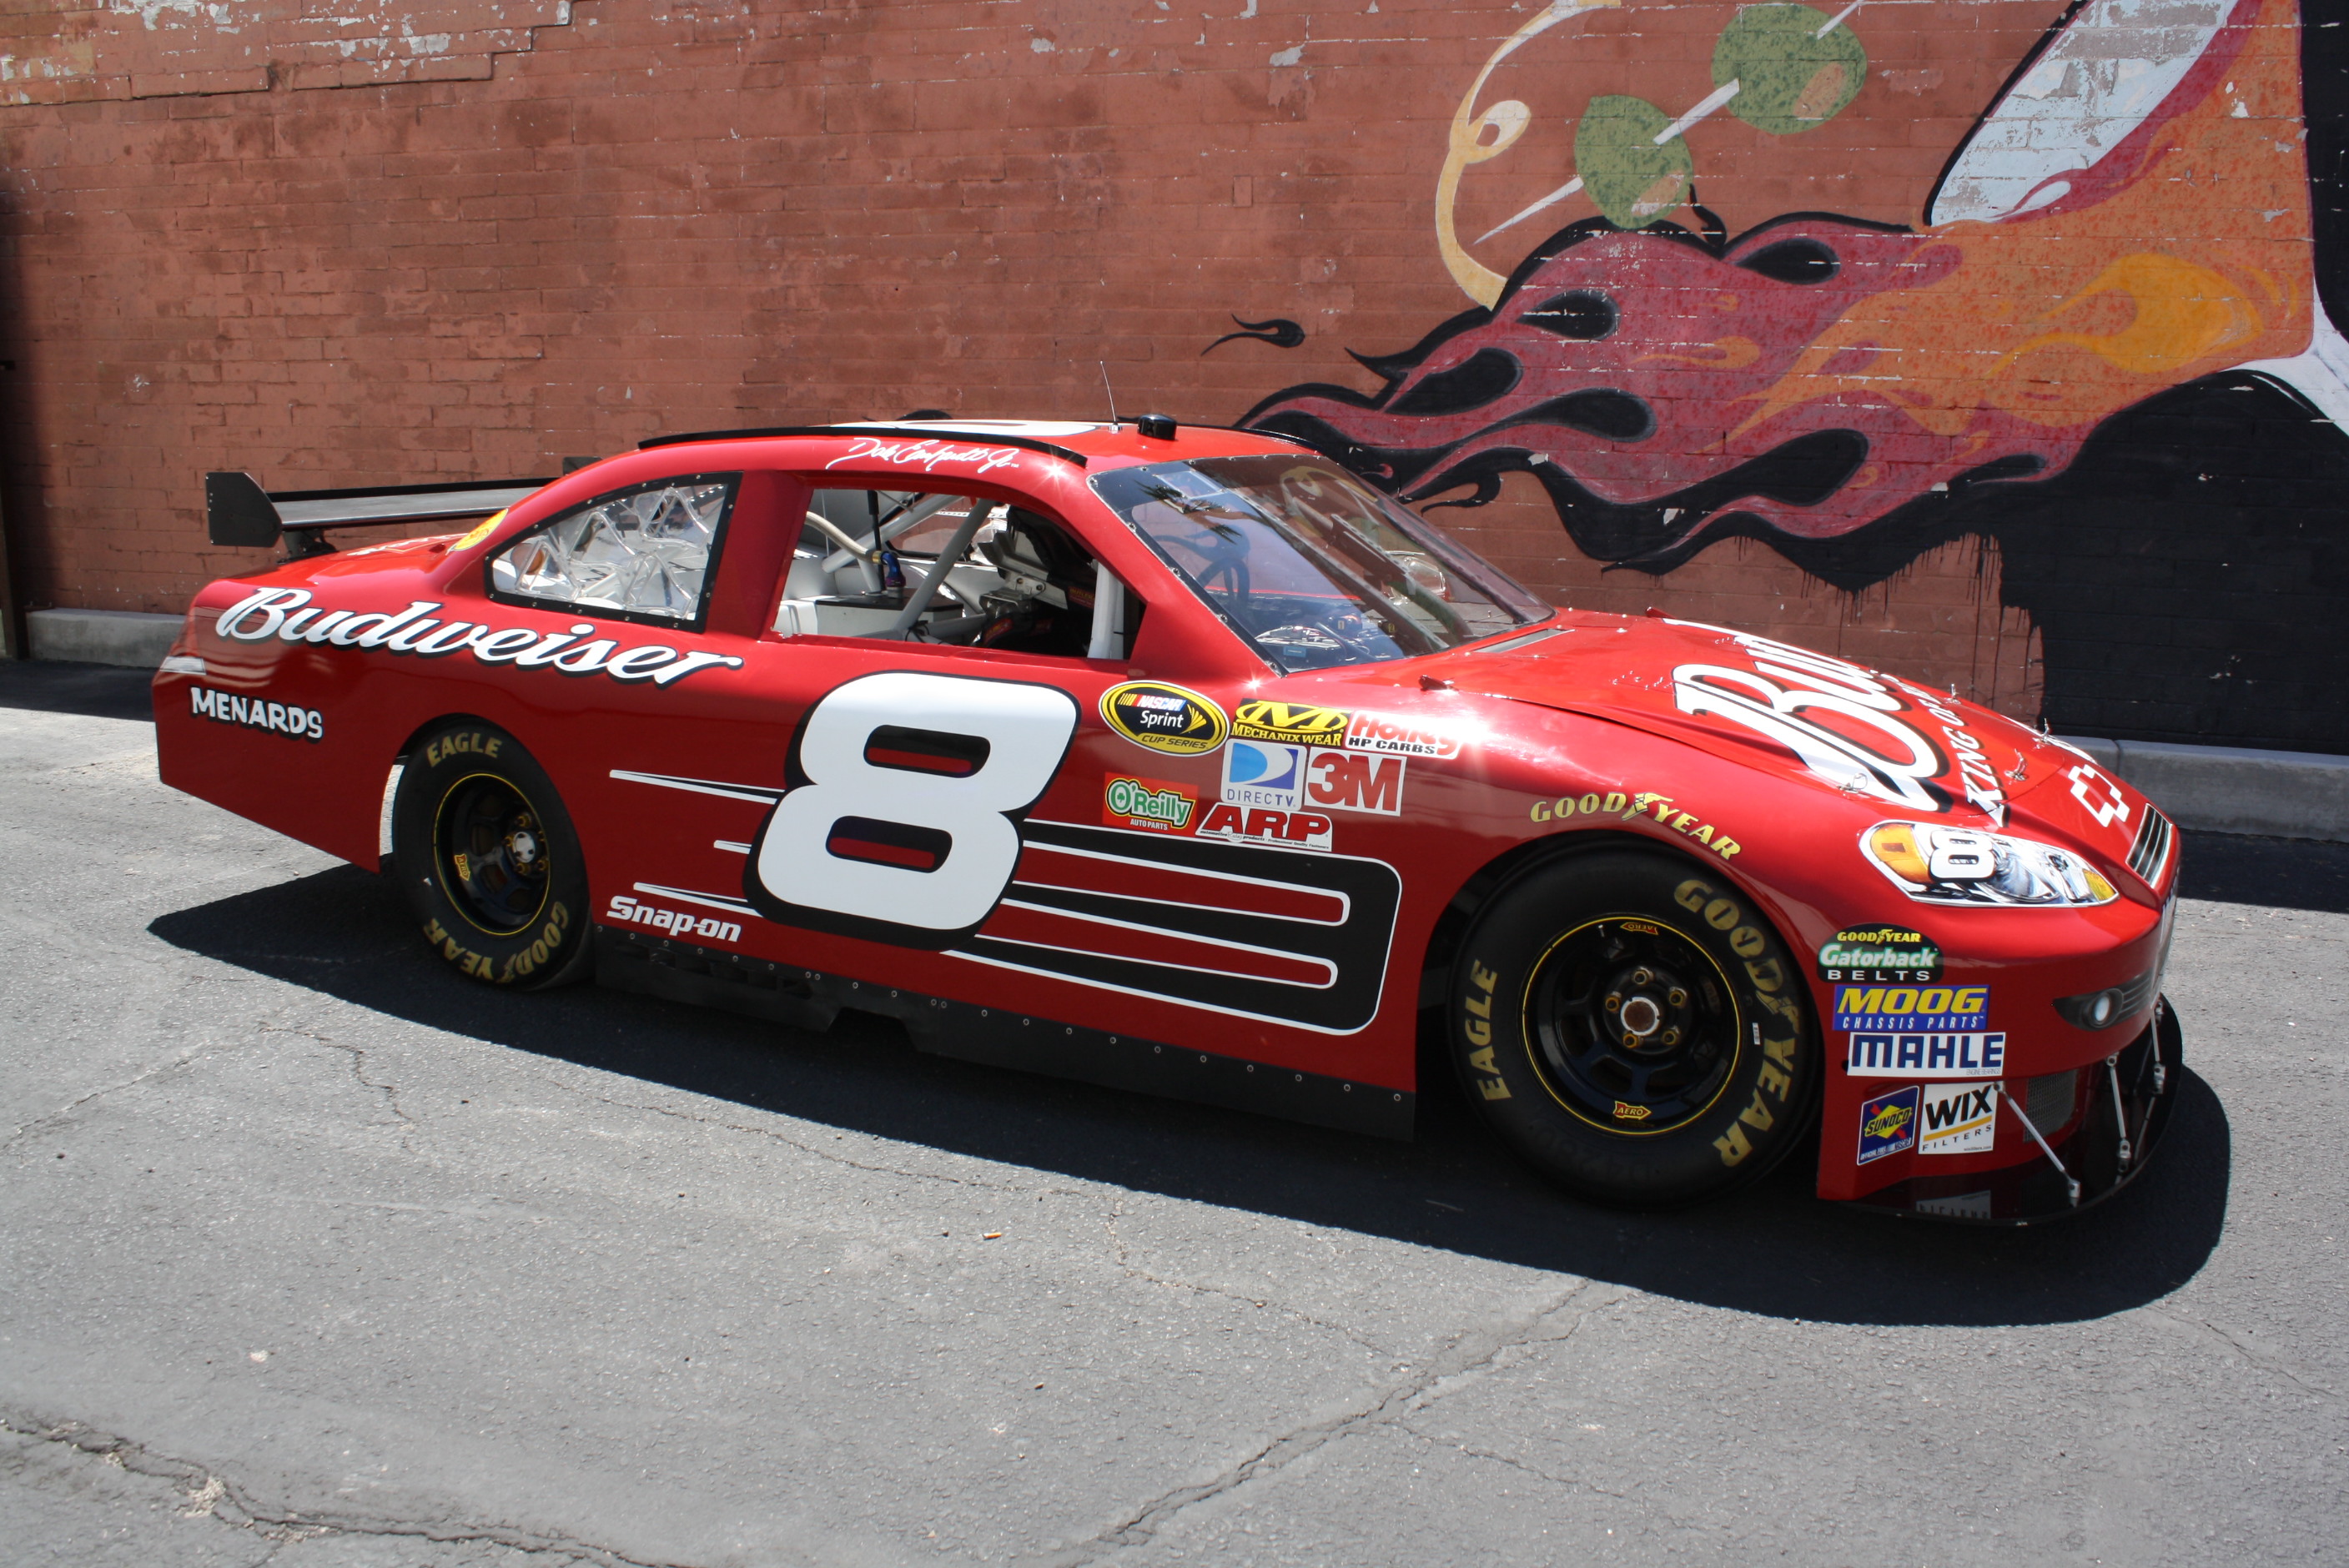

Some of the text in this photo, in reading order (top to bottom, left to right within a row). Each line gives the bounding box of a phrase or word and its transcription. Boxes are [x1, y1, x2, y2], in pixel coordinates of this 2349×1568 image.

[214, 587, 744, 686] Budweiser
[190, 686, 324, 740] MENARDS
[1137, 695, 1183, 711] NASCAR
[1139, 710, 1185, 729] Sprint
[1230, 721, 1342, 746] MECHANIX WEAR
[426, 732, 502, 768] EAGLE
[1141, 735, 1208, 749] CUP SERIES
[1348, 736, 1436, 755] HP CARBS
[1307, 751, 1402, 812] 3M
[1940, 725, 2004, 828] KING
[757, 671, 1078, 932] 8
[1110, 783, 1189, 824] O'Reilly
[1226, 788, 1295, 807] DIRECTV
[1129, 818, 1168, 831] AUTO PARTS
[1201, 804, 1330, 842] ARP
[1929, 829, 1996, 880] 8
[606, 895, 742, 943] Snap-on
[1819, 942, 1939, 968] Gatorback
[1827, 969, 1930, 982] BELTS
[1837, 988, 1988, 1014] MOOG
[1464, 957, 1512, 1101] EAGLE
[1842, 1016, 1979, 1030] CHASSIS PARTS
[1851, 1033, 2004, 1068] MAHLE
[1617, 1107, 1643, 1117] AERO
[1924, 1084, 1993, 1131] WIX
[1866, 1108, 1911, 1136] SUNOCO
[1922, 1124, 1992, 1152] FILTERS
